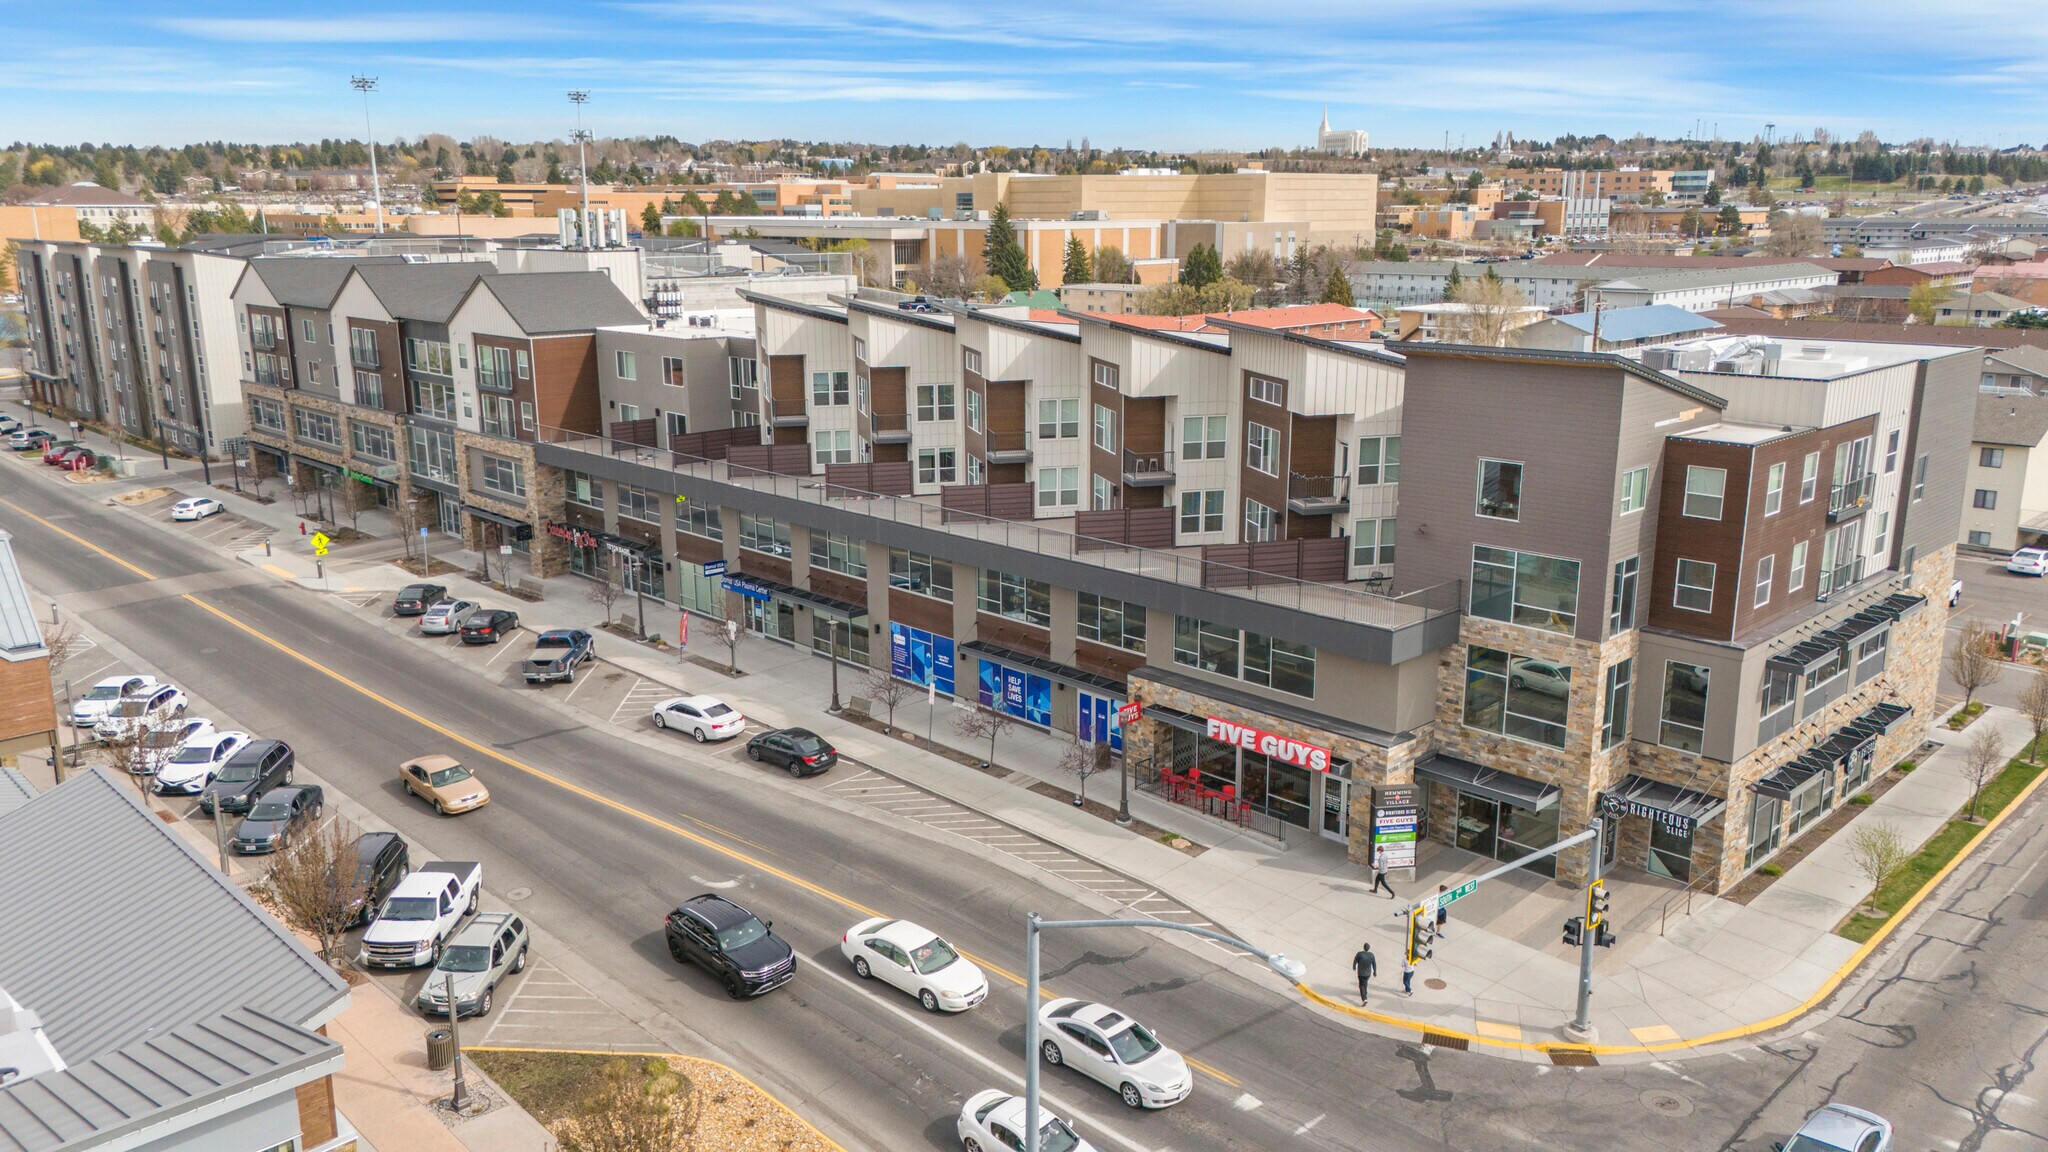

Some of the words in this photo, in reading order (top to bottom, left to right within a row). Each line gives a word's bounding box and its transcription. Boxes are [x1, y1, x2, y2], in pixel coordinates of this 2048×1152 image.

[1008, 675, 1022, 686] HELP
[1008, 683, 1022, 694] SAVE
[1008, 692, 1023, 703] LIVES
[1207, 718, 1256, 750] FIVE
[1261, 735, 1326, 771] GUYS
[1629, 803, 1689, 830] RIGHTEOUS
[1666, 825, 1688, 838] SLICE
[1440, 893, 1452, 906] SOUTH
[1465, 881, 1475, 893] WEST
